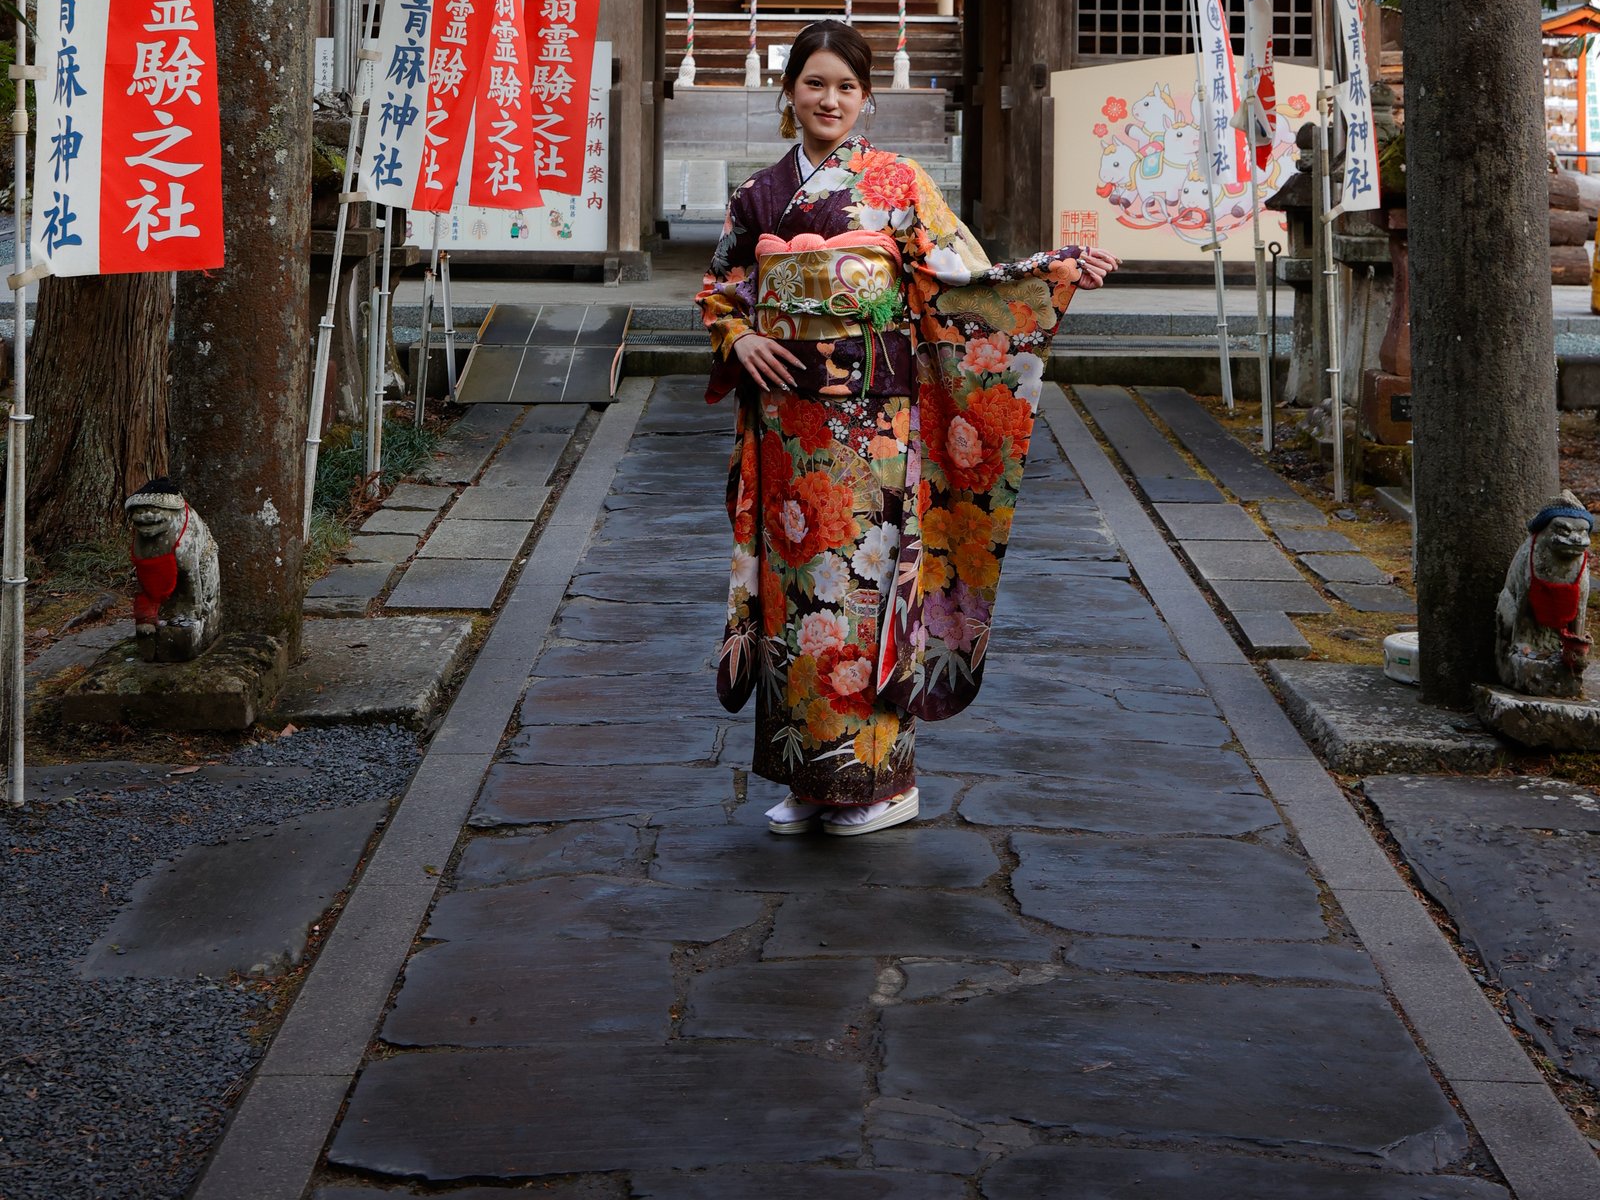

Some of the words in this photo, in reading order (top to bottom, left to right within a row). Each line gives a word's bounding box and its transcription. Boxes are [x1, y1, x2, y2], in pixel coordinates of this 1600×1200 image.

[586, 87, 605, 211] ご祈祷案内
[1210, 37, 1231, 176] 青麻神社
[1346, 17, 1372, 200] 青麻神社
